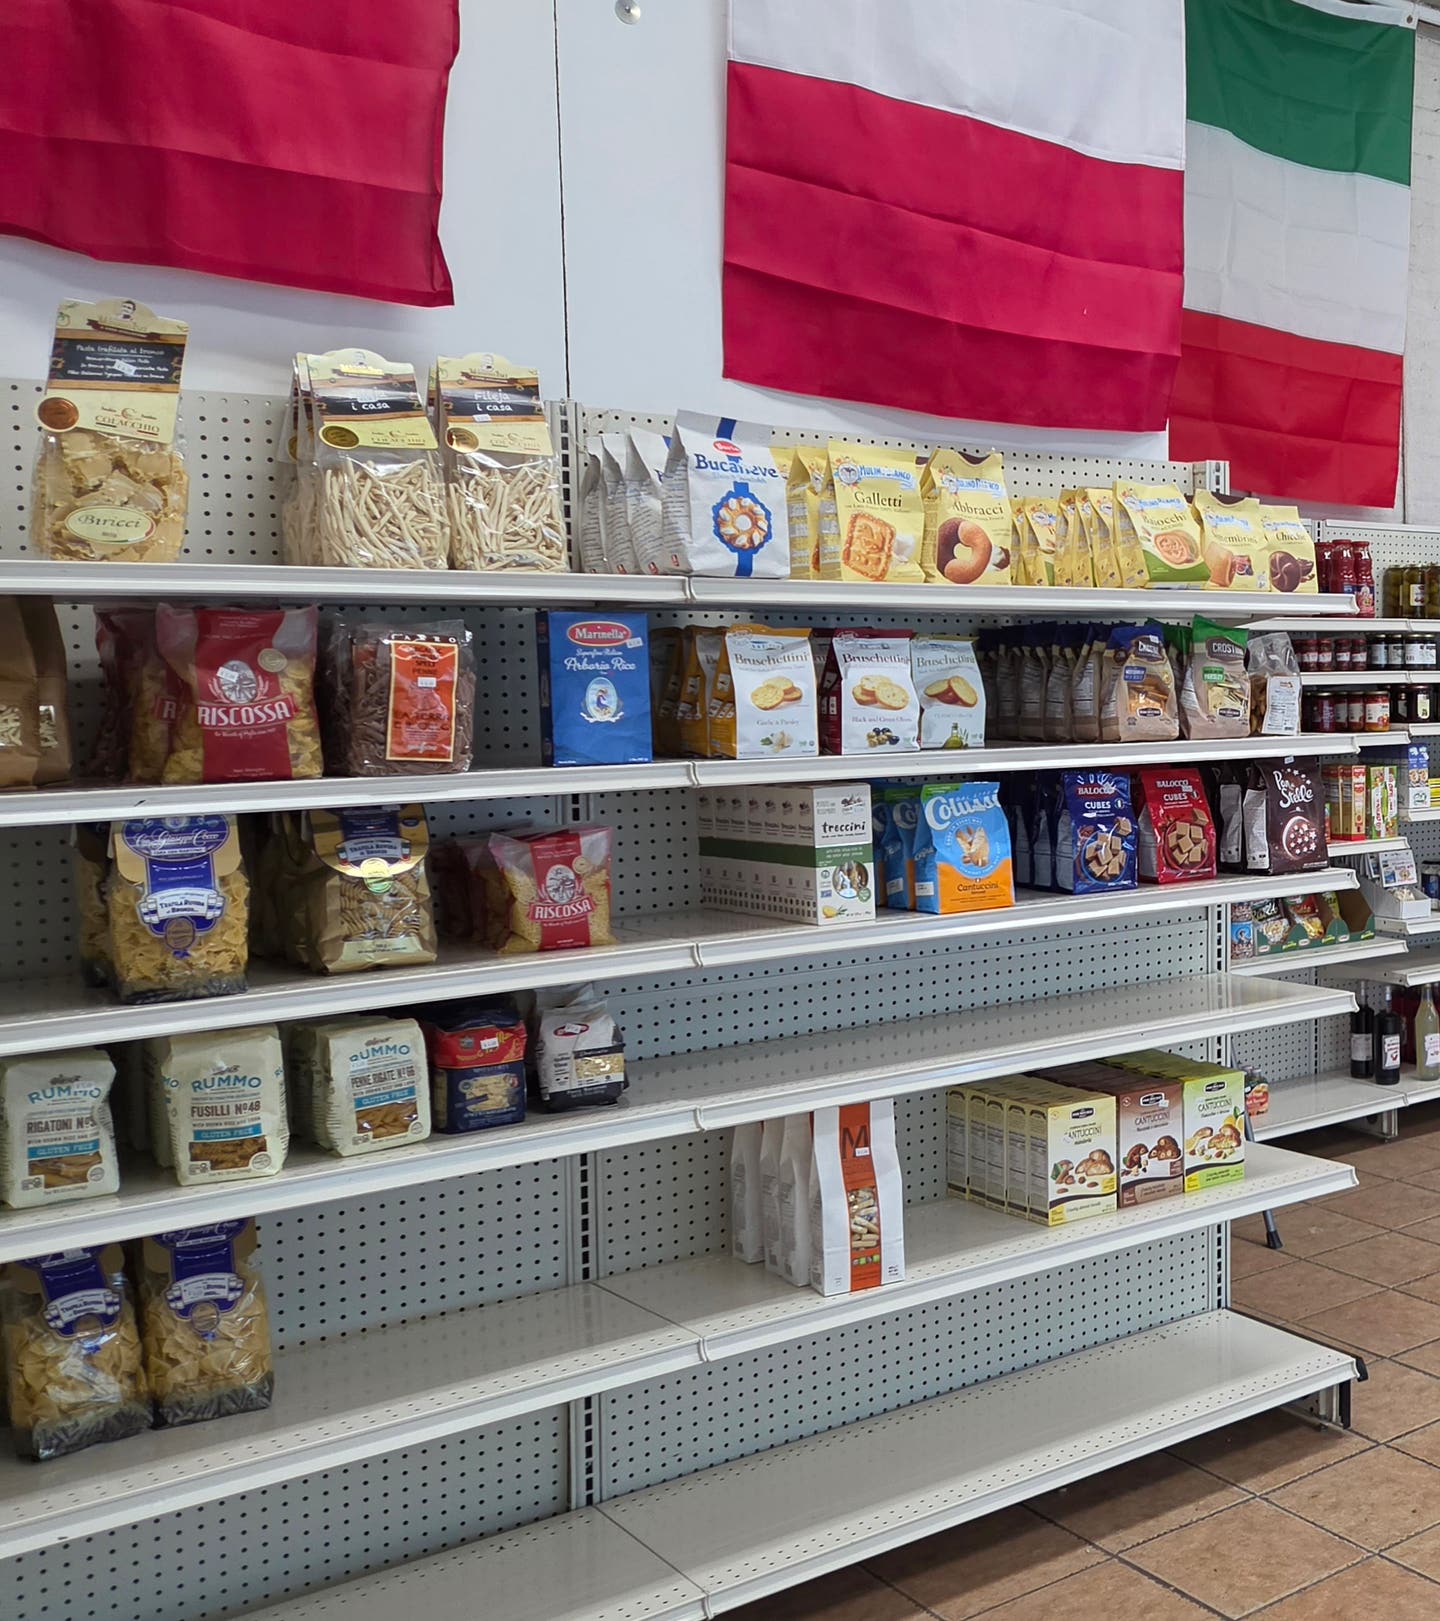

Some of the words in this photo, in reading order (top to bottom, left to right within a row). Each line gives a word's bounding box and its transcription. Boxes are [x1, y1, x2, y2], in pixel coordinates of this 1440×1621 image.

[362, 402, 391, 411] casa
[487, 403, 513, 412] casa
[854, 490, 902, 508] Galletti
[953, 500, 1003, 516] Abbracci
[575, 626, 624, 640] Marinella
[564, 656, 610, 672] Arborio
[611, 656, 637, 672] Rice
[734, 651, 807, 666] Bruschettini
[842, 652, 911, 666] Bruschettini
[198, 700, 291, 726] RISCOSSA
[1156, 779, 1188, 788] BALOCCO
[1273, 770, 1290, 791] Pan
[1163, 793, 1188, 801] CUBES
[1279, 784, 1314, 808] Stelle
[925, 788, 1002, 831] Colussi
[1084, 801, 1111, 809] CUBES
[822, 821, 866, 834] treccini
[957, 881, 999, 892] Cantuccini
[534, 899, 592, 919] RISCOSSA
[191, 1074, 262, 1093] RUMMO
[351, 1074, 371, 1089] PENNE
[372, 1069, 396, 1085] RIGATE
[190, 1105, 231, 1118] FUSILLI
[26, 1118, 73, 1134] RIGATONI
[201, 1129, 231, 1139] GLUTEN
[36, 1145, 71, 1156] GLUTEN
[73, 1142, 95, 1152] FREE
[842, 1125, 869, 1159] M
